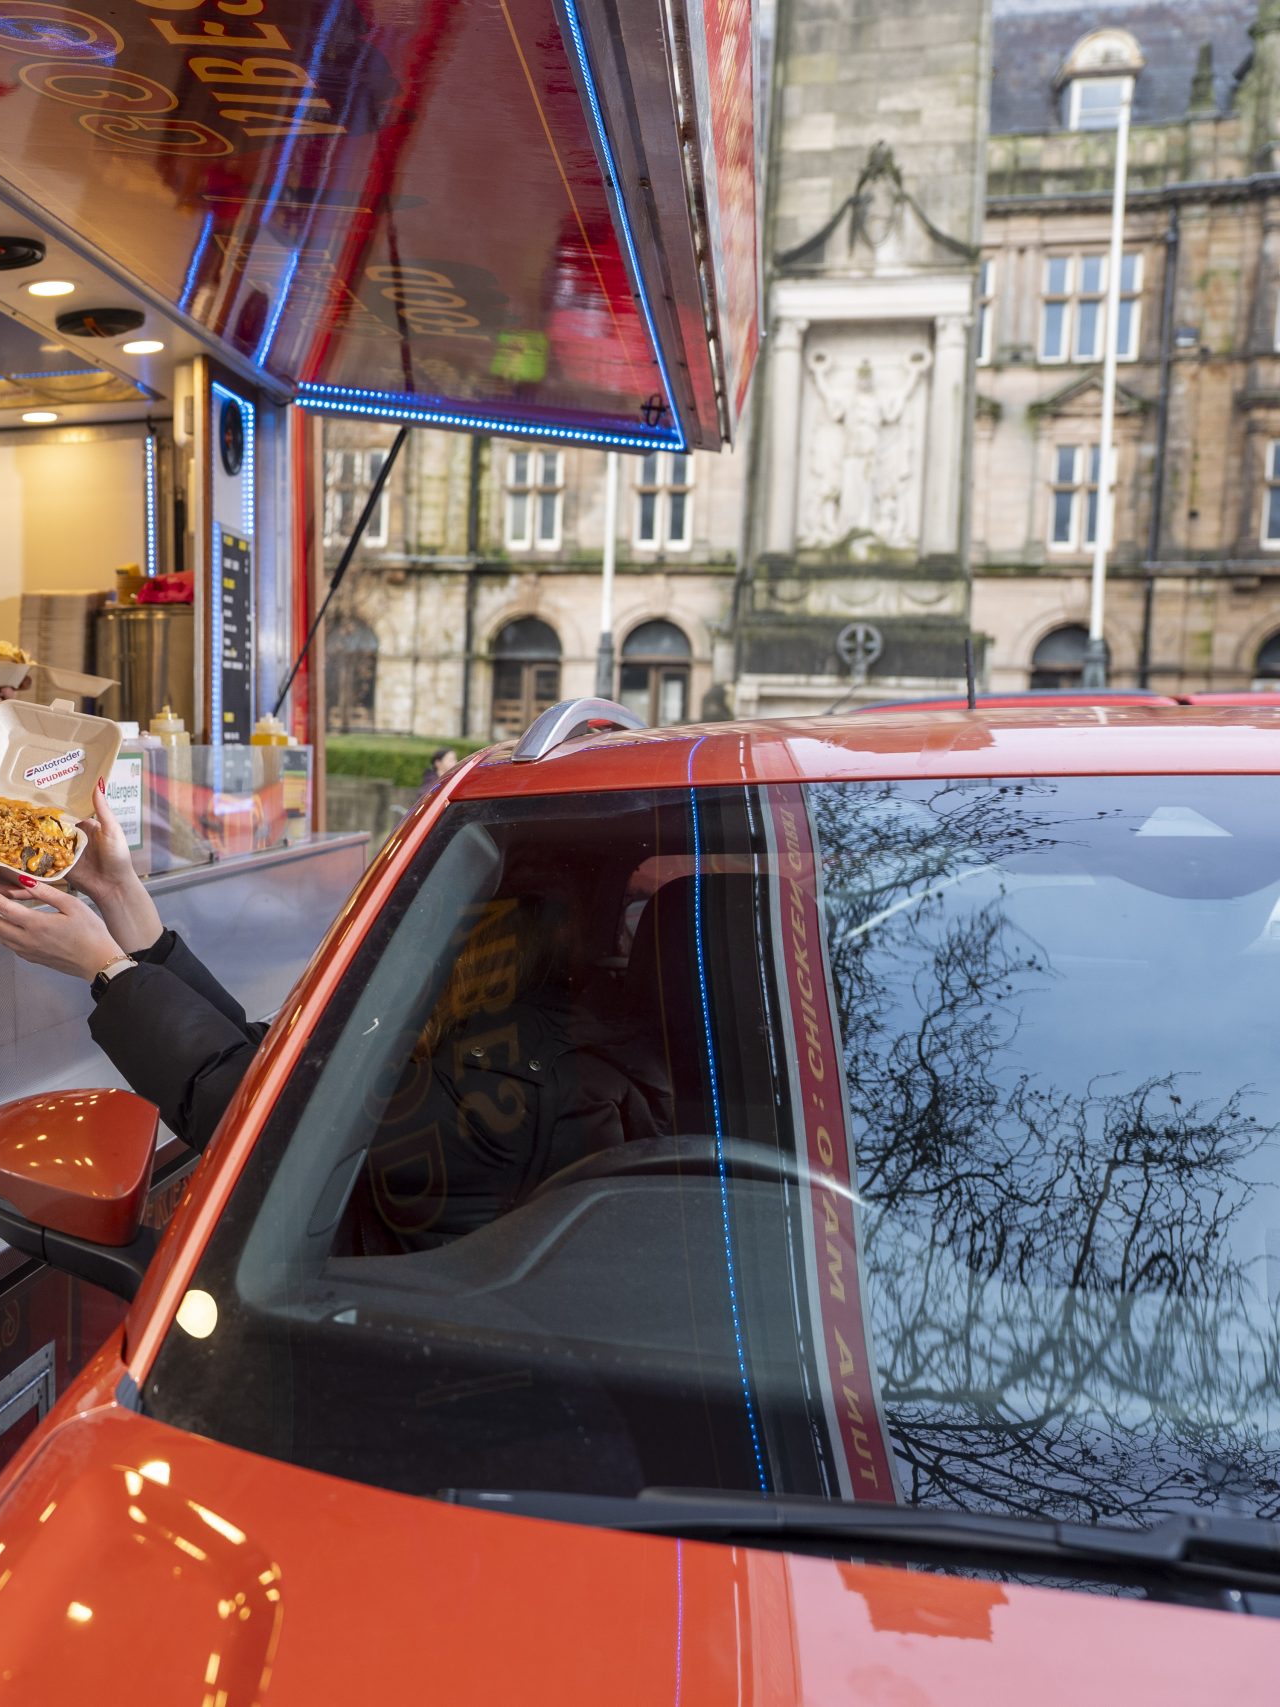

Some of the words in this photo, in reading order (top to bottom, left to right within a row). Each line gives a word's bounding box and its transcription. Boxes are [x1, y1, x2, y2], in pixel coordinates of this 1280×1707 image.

[364, 265, 491, 341] FOOD
[33, 749, 81, 774] Autotrader
[36, 764, 80, 786] SPUDBROS
[106, 783, 138, 802] Allergens
